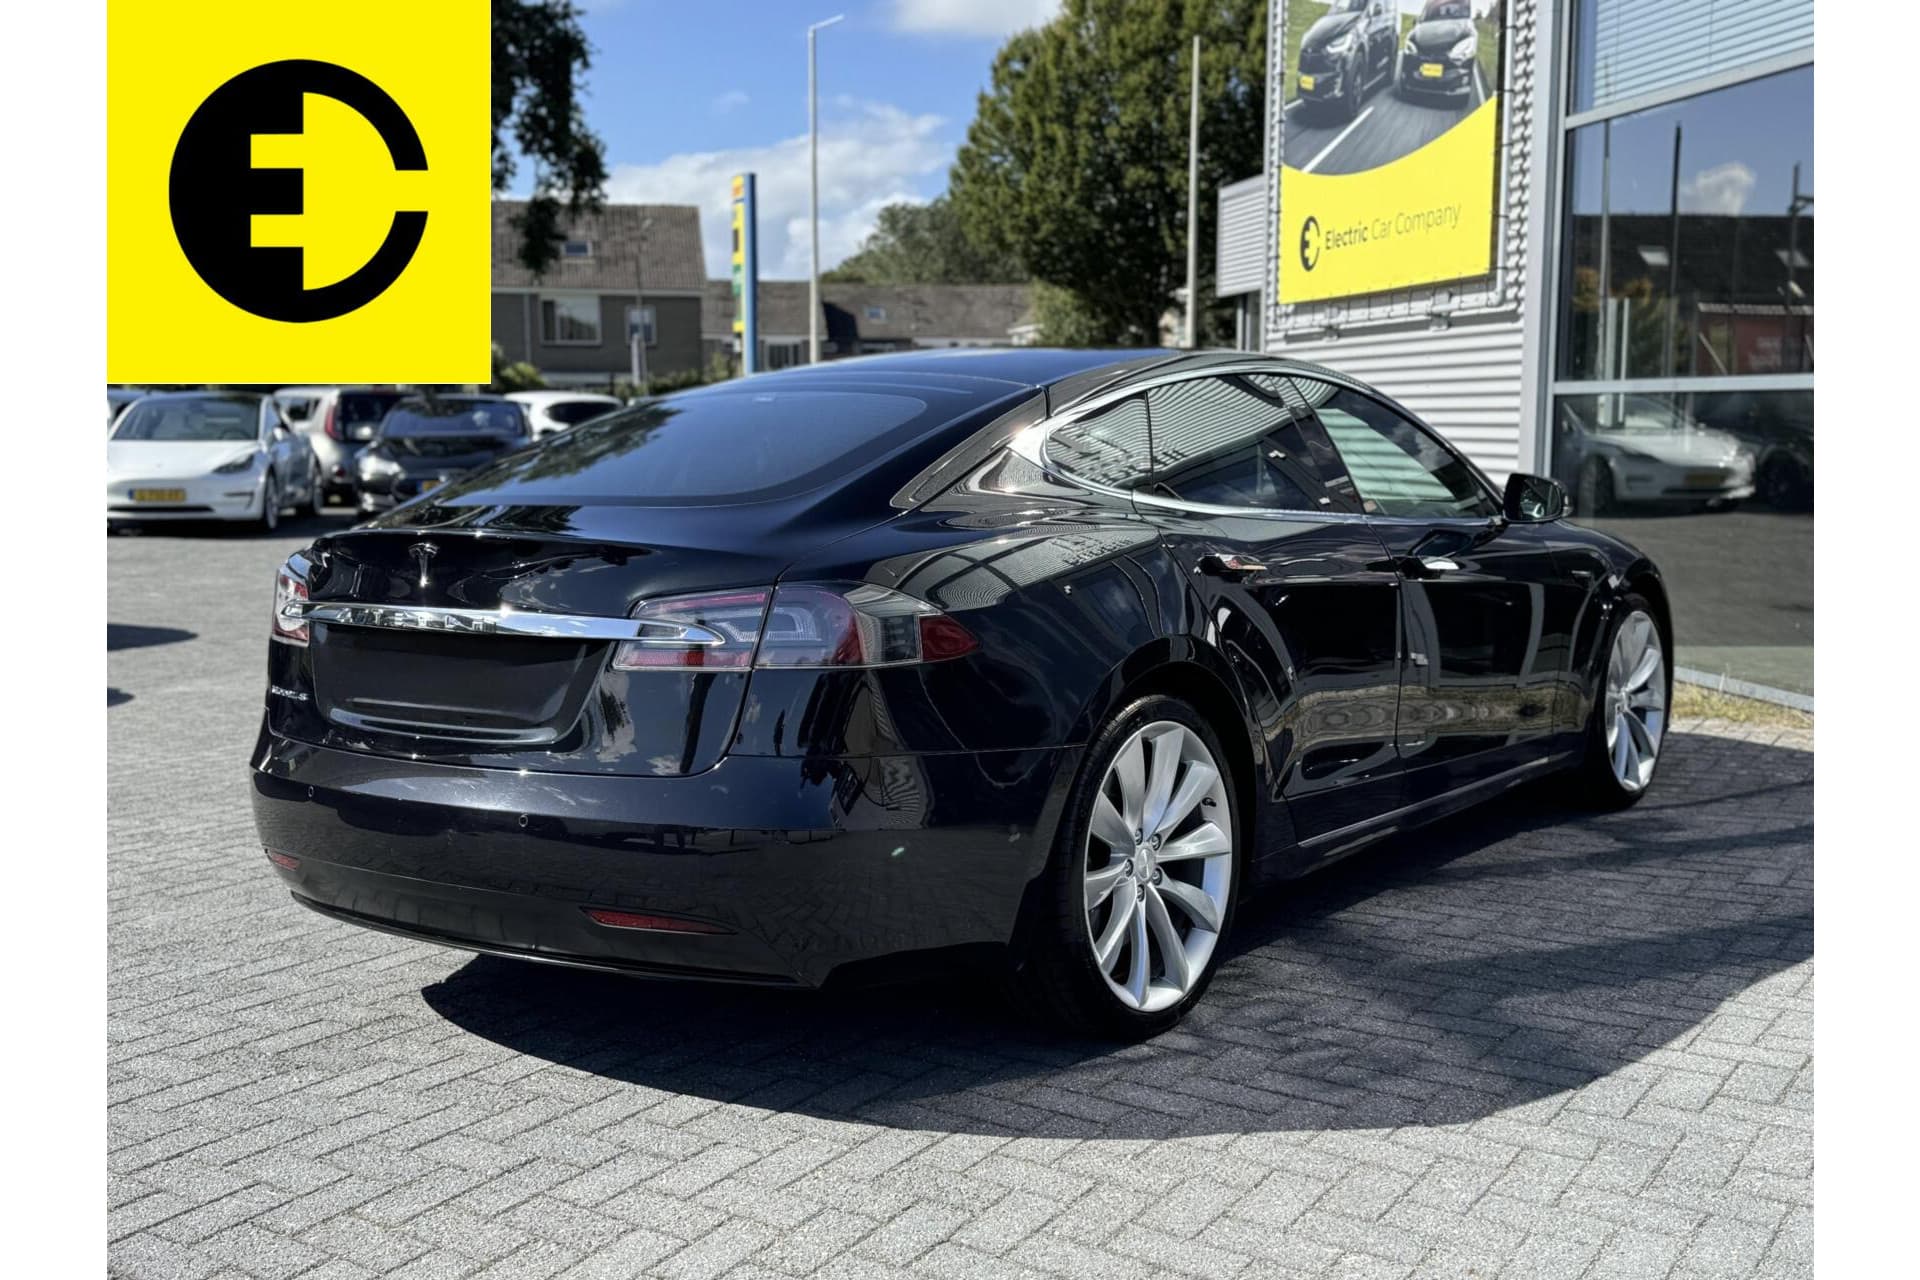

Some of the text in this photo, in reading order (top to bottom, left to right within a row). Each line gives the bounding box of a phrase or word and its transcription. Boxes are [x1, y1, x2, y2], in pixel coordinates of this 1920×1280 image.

[1325, 220, 1369, 250] Electric
[1371, 217, 1392, 241] Car
[1395, 202, 1462, 235] Company
